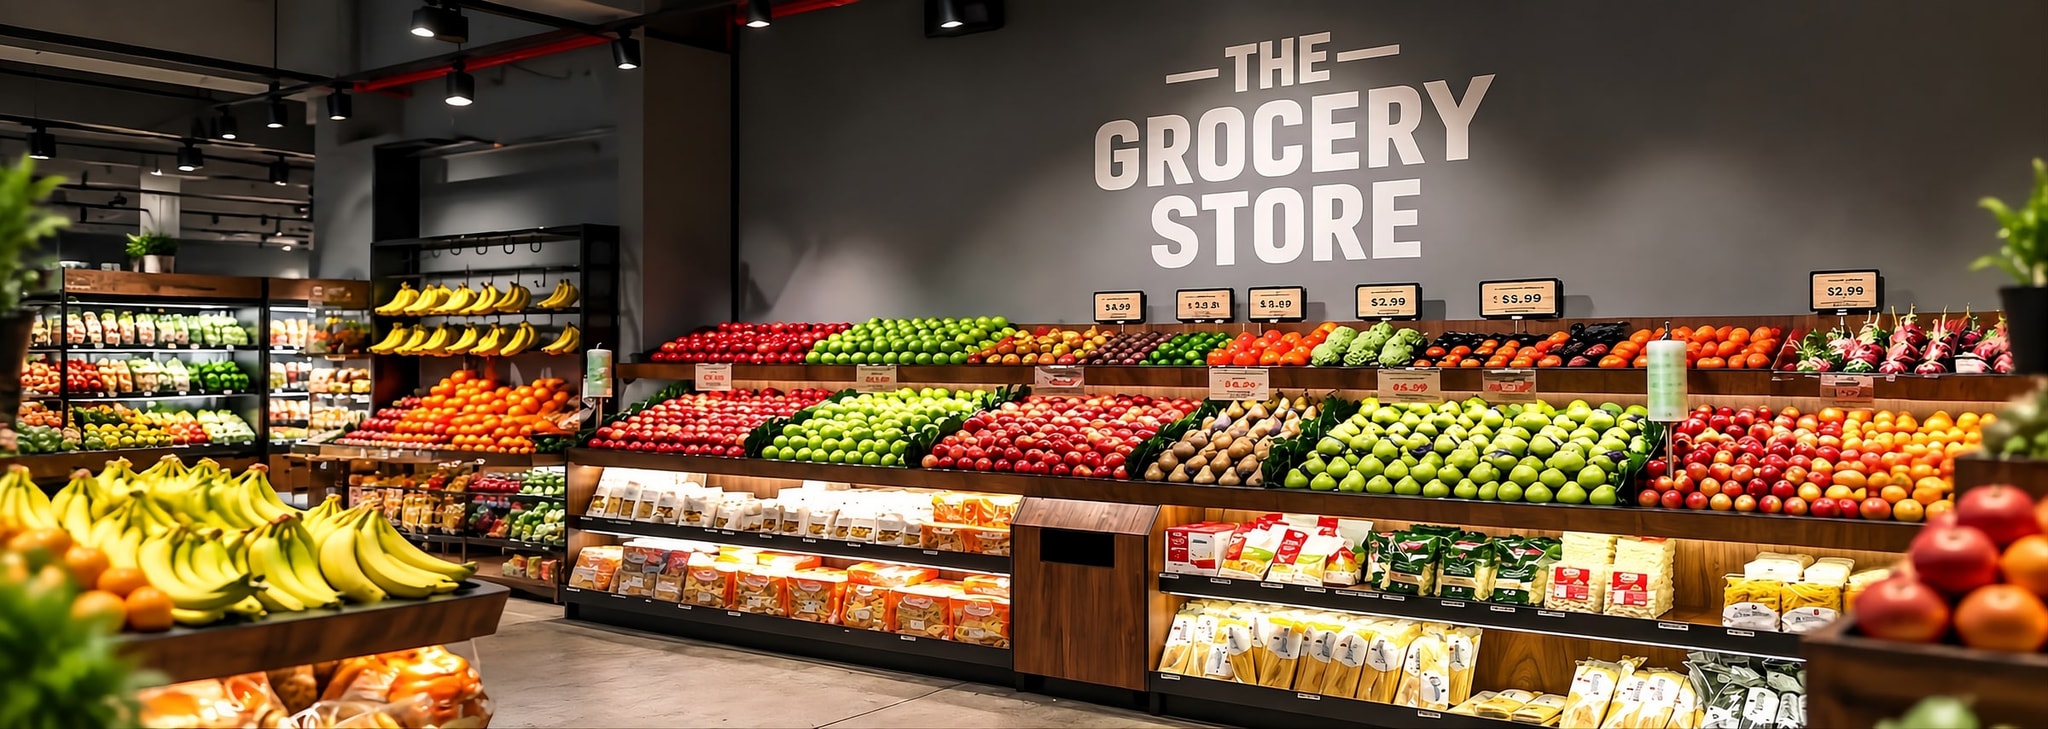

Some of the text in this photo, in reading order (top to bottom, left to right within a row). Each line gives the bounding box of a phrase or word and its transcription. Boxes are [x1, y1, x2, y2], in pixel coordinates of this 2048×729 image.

[1225, 31, 1331, 93] THE
[1094, 73, 1496, 191] GROCERY
[1151, 178, 1421, 269] STORE
[1371, 297, 1406, 307] $2.99
[1827, 286, 1864, 296] $2.99
